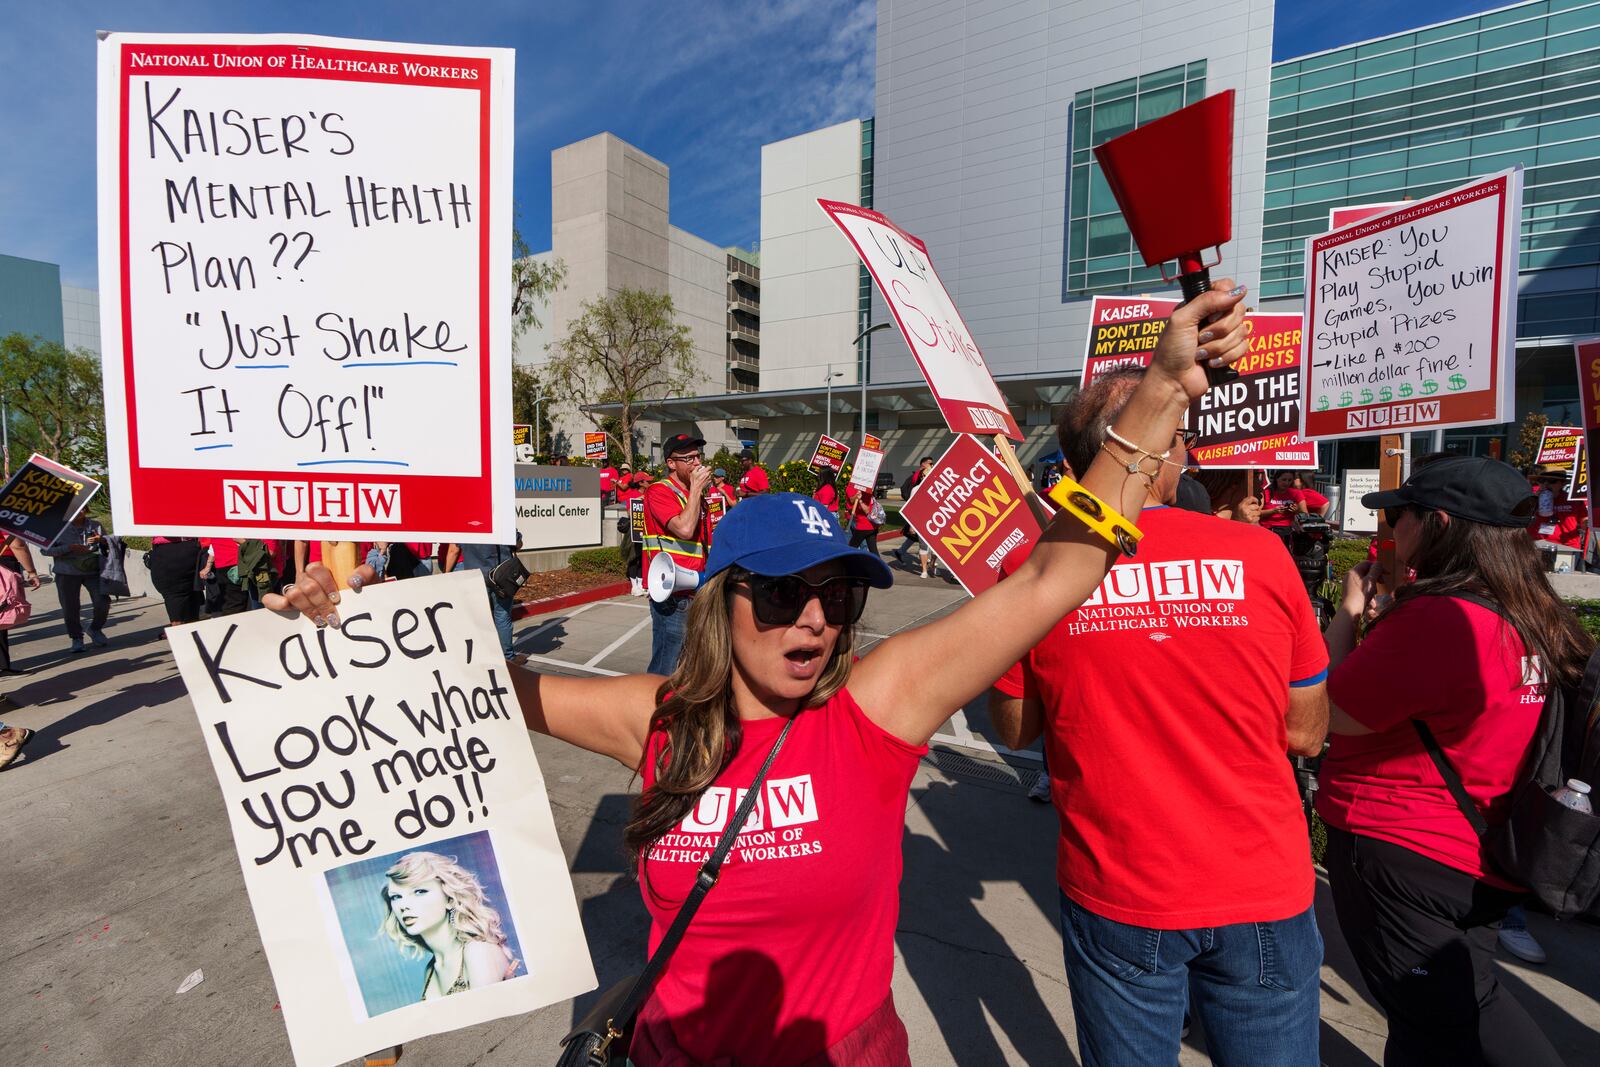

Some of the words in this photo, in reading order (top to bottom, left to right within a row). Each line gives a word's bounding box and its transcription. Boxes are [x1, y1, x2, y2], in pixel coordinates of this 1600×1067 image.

[130, 52, 209, 68] NATIONAL
[213, 53, 263, 69] UNION
[267, 54, 286, 68] OF
[290, 54, 399, 75] HEALTHCARE
[401, 61, 479, 81] WORKERS
[144, 80, 355, 163] KAISER'S
[165, 175, 331, 224] MENTAL
[344, 175, 472, 229] HEALTH
[1317, 231, 1354, 249] NATIONAL
[1355, 222, 1380, 237] UNION
[1381, 217, 1393, 230] OF
[1393, 198, 1451, 223] HEALTHCARE
[1452, 183, 1499, 205] WORKERS
[1320, 280, 1358, 306] Play
[1368, 249, 1444, 290] Stupid
[1098, 323, 1140, 341] DON'T
[1142, 320, 1168, 335] DEN
[1100, 304, 1153, 322] KAISER,
[1317, 320, 1379, 350] Stupid
[1390, 308, 1457, 335] Prizes
[315, 311, 468, 361] Shake
[1095, 340, 1117, 355] MY
[1118, 335, 1159, 353] PATIEN
[1201, 382, 1248, 411] END
[1254, 372, 1298, 401] THE
[180, 385, 240, 437] It
[1348, 402, 1440, 429] NUHW
[1197, 434, 1303, 461] KAISERDONTDENY.O
[1275, 451, 1310, 461] NUHW
[11, 482, 65, 504] DONT
[23, 469, 84, 495] KAISER
[925, 458, 992, 537] CONTRACT
[927, 466, 960, 503] FAIR
[0, 494, 53, 516] DENY
[226, 483, 399, 520] NUHW
[558, 505, 590, 517] Center
[792, 500, 833, 537] LA
[940, 475, 1012, 560] NOW
[986, 527, 1025, 569] NUHW
[1082, 563, 1242, 602] UHW
[1068, 617, 1169, 635] HEALTHCARE
[1173, 615, 1249, 628] WORKERS
[1077, 605, 1155, 621] NATIONAL
[1159, 602, 1212, 616] UNION
[1216, 602, 1236, 613] OF
[191, 601, 474, 703] Kaiser,
[1520, 694, 1546, 704] HEA
[214, 694, 398, 783] Look
[397, 669, 511, 739] what
[241, 768, 356, 866] you
[371, 728, 497, 794] made
[285, 817, 376, 868] me
[394, 770, 490, 840] do!!
[653, 834, 719, 849] ATIONAL
[782, 828, 803, 841] OF
[741, 841, 823, 863] WORKERS
